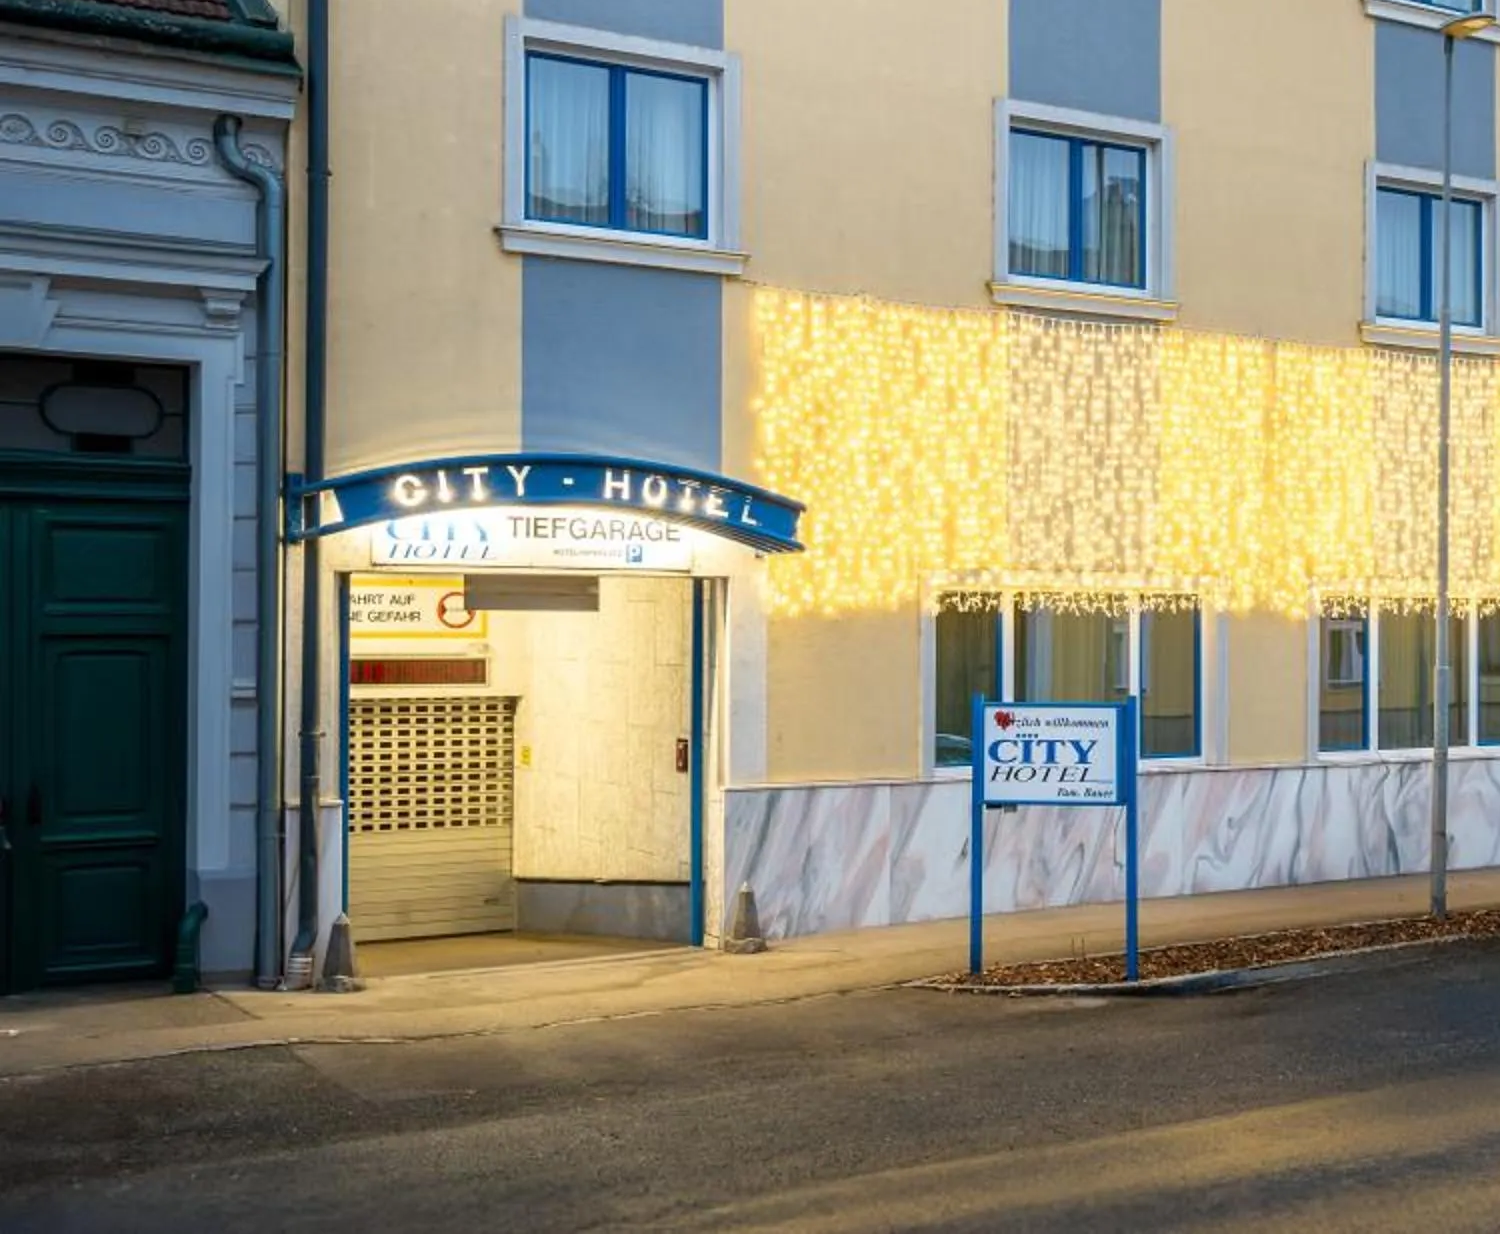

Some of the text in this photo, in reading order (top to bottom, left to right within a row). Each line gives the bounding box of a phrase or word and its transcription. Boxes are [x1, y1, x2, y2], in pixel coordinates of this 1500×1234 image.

[392, 465, 531, 507] CITY
[602, 468, 763, 527] HOTEL
[507, 515, 682, 543] TIEFGARAGE
[350, 593, 416, 606] AHRT AUF
[366, 610, 422, 623] GEFAHR
[988, 739, 1098, 764] CITY
[990, 766, 1106, 783] HOTEL
